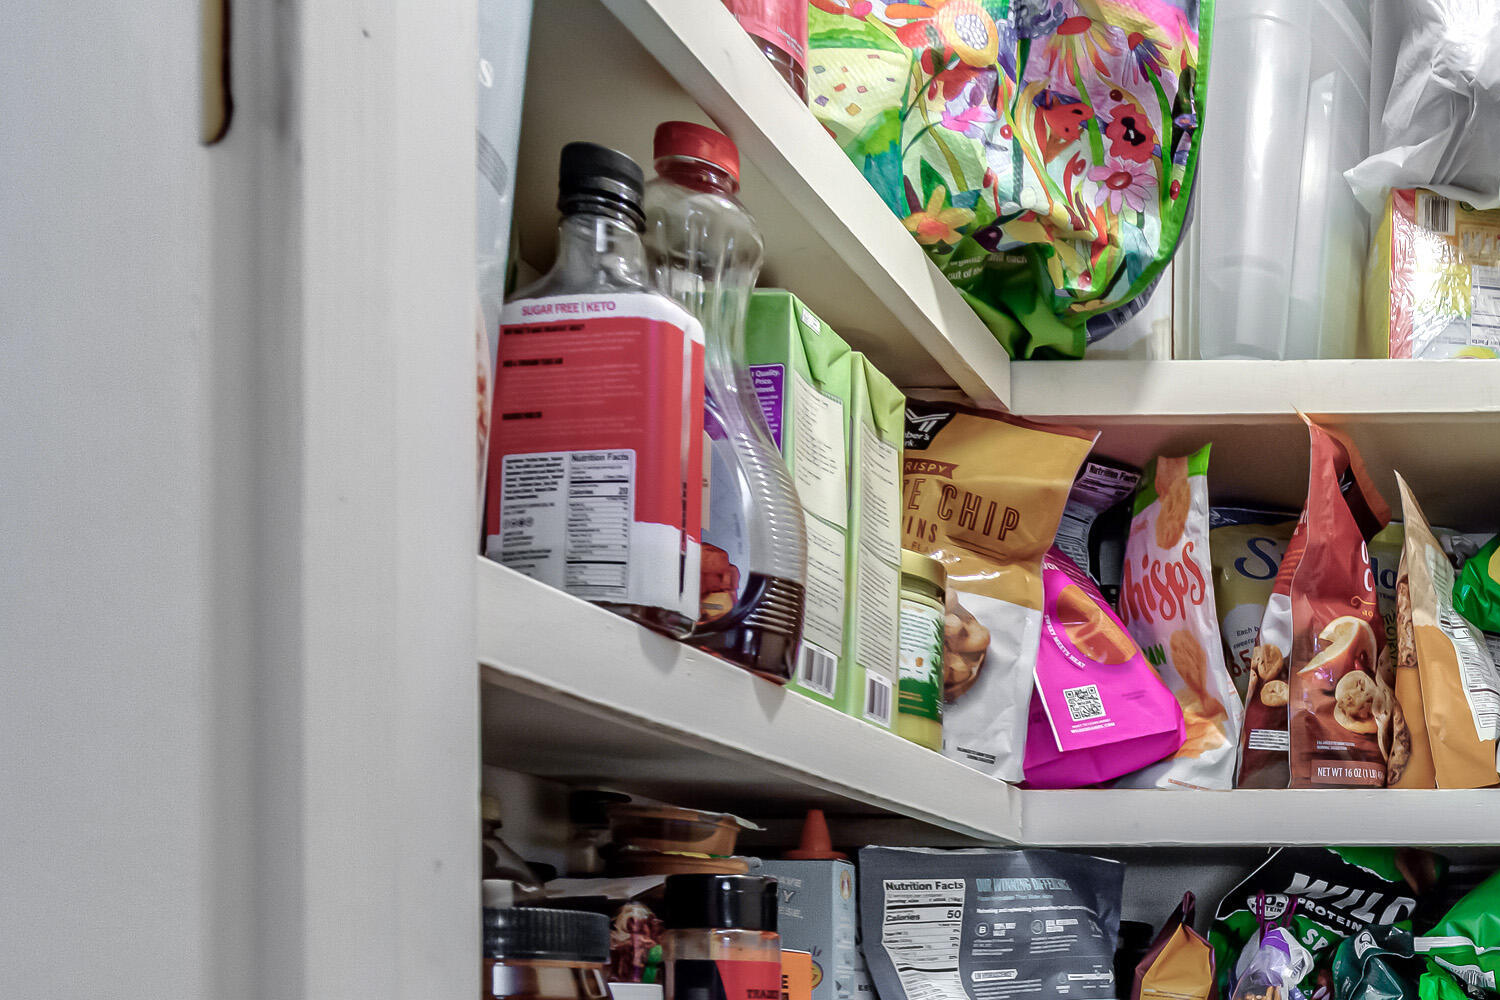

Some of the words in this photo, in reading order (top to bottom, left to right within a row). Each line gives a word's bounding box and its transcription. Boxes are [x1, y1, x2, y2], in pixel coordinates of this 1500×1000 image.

[521, 302, 553, 316] SUGAR
[554, 302, 579, 314] FREE
[586, 301, 616, 312] KETO
[937, 484, 1021, 542] CHIP
[1317, 767, 1331, 777] NET
[1331, 767, 1343, 777] WT
[886, 882, 934, 892] Nutrition
[935, 881, 964, 891] Facts
[886, 912, 921, 922] Calories
[946, 909, 961, 920] 50
[1297, 897, 1363, 933] PROTEIN
